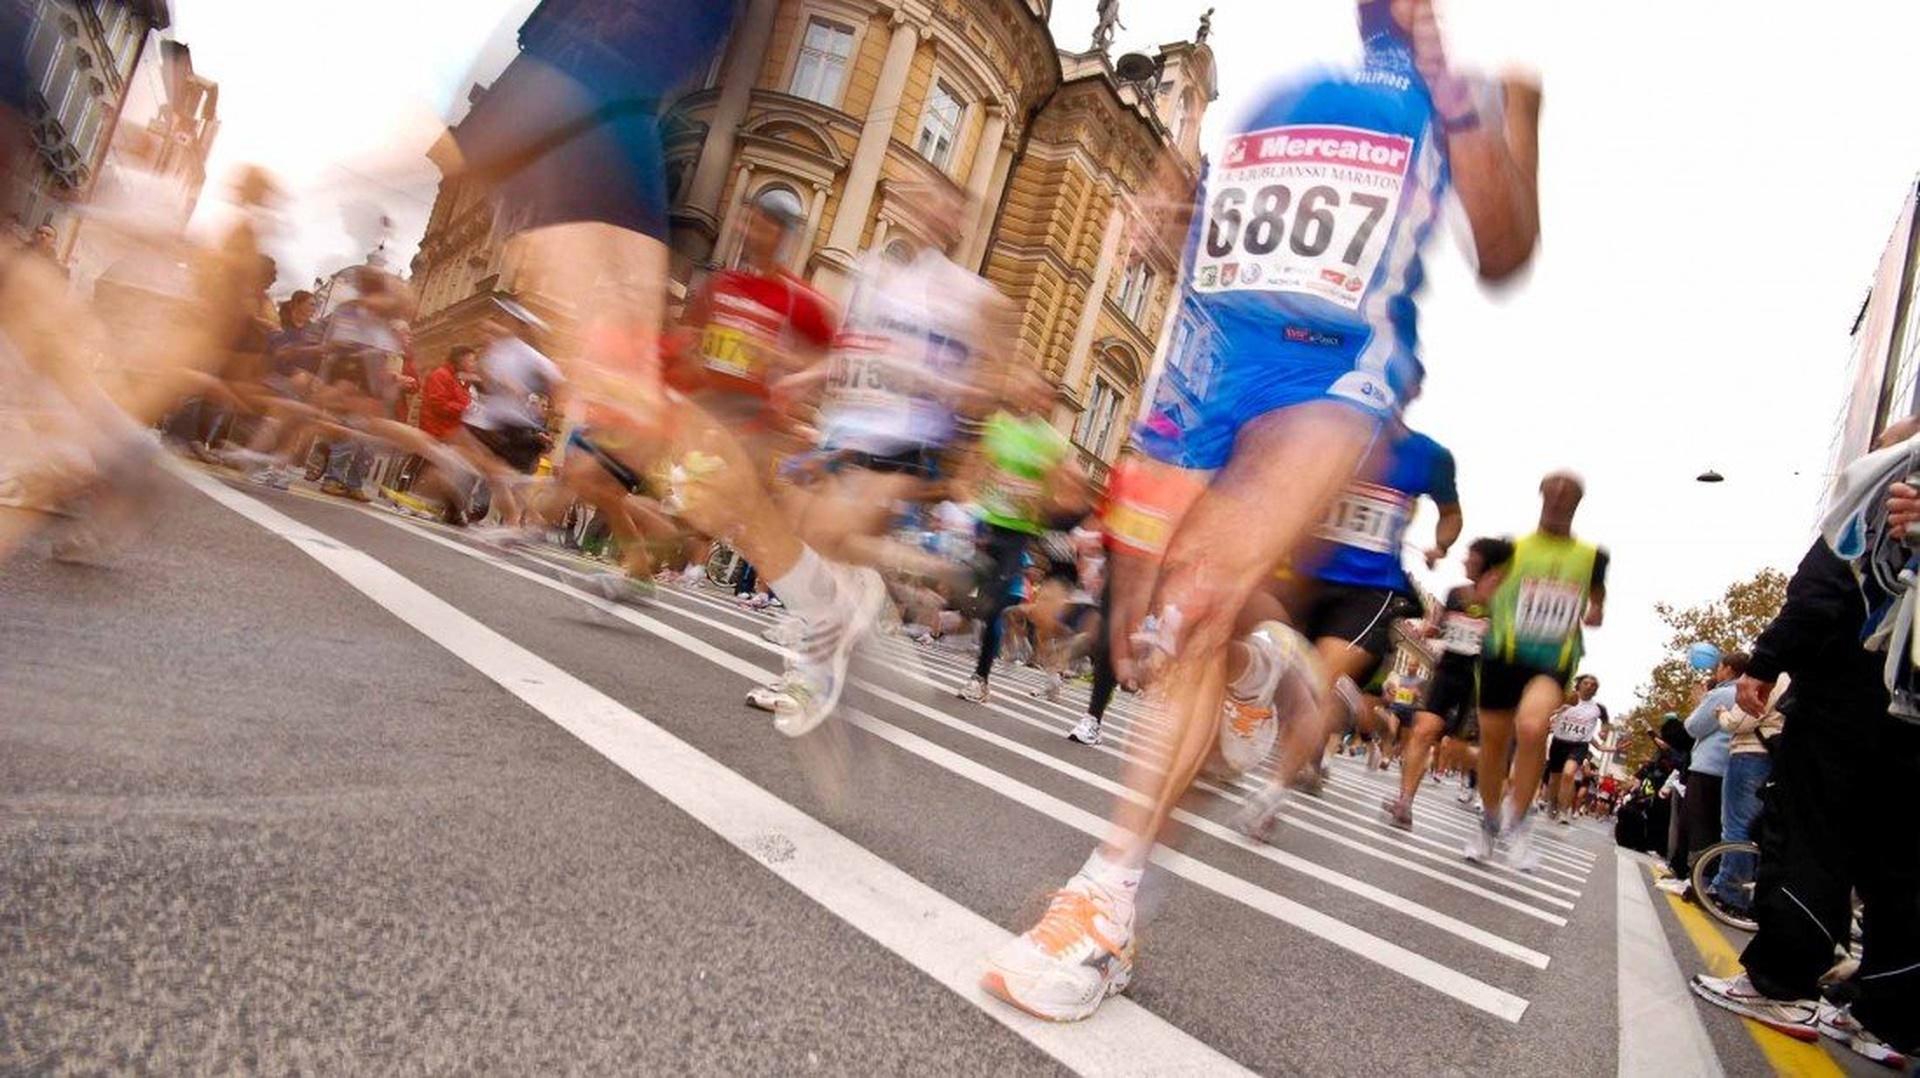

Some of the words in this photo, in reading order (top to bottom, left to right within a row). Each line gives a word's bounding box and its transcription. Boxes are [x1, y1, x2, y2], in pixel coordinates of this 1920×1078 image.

[1259, 135, 1405, 167] Mercator
[1332, 167, 1401, 192] MARATON
[1206, 184, 1389, 266] 6867
